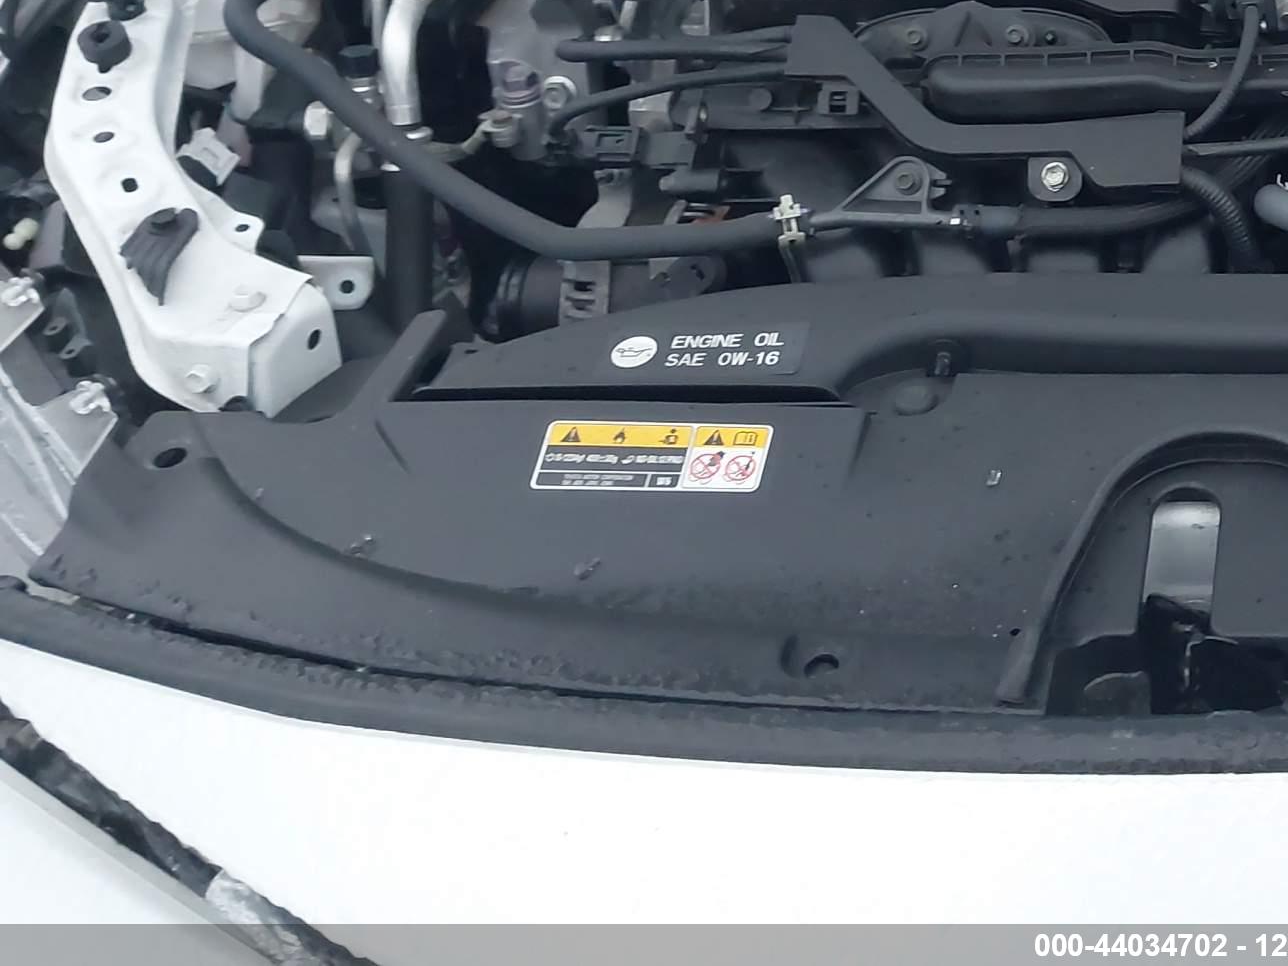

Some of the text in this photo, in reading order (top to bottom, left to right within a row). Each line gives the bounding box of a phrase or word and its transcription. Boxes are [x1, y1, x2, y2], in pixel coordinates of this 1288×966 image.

[670, 332, 785, 350] ENGINE OIL
[663, 350, 781, 367] SAE 0W-16
